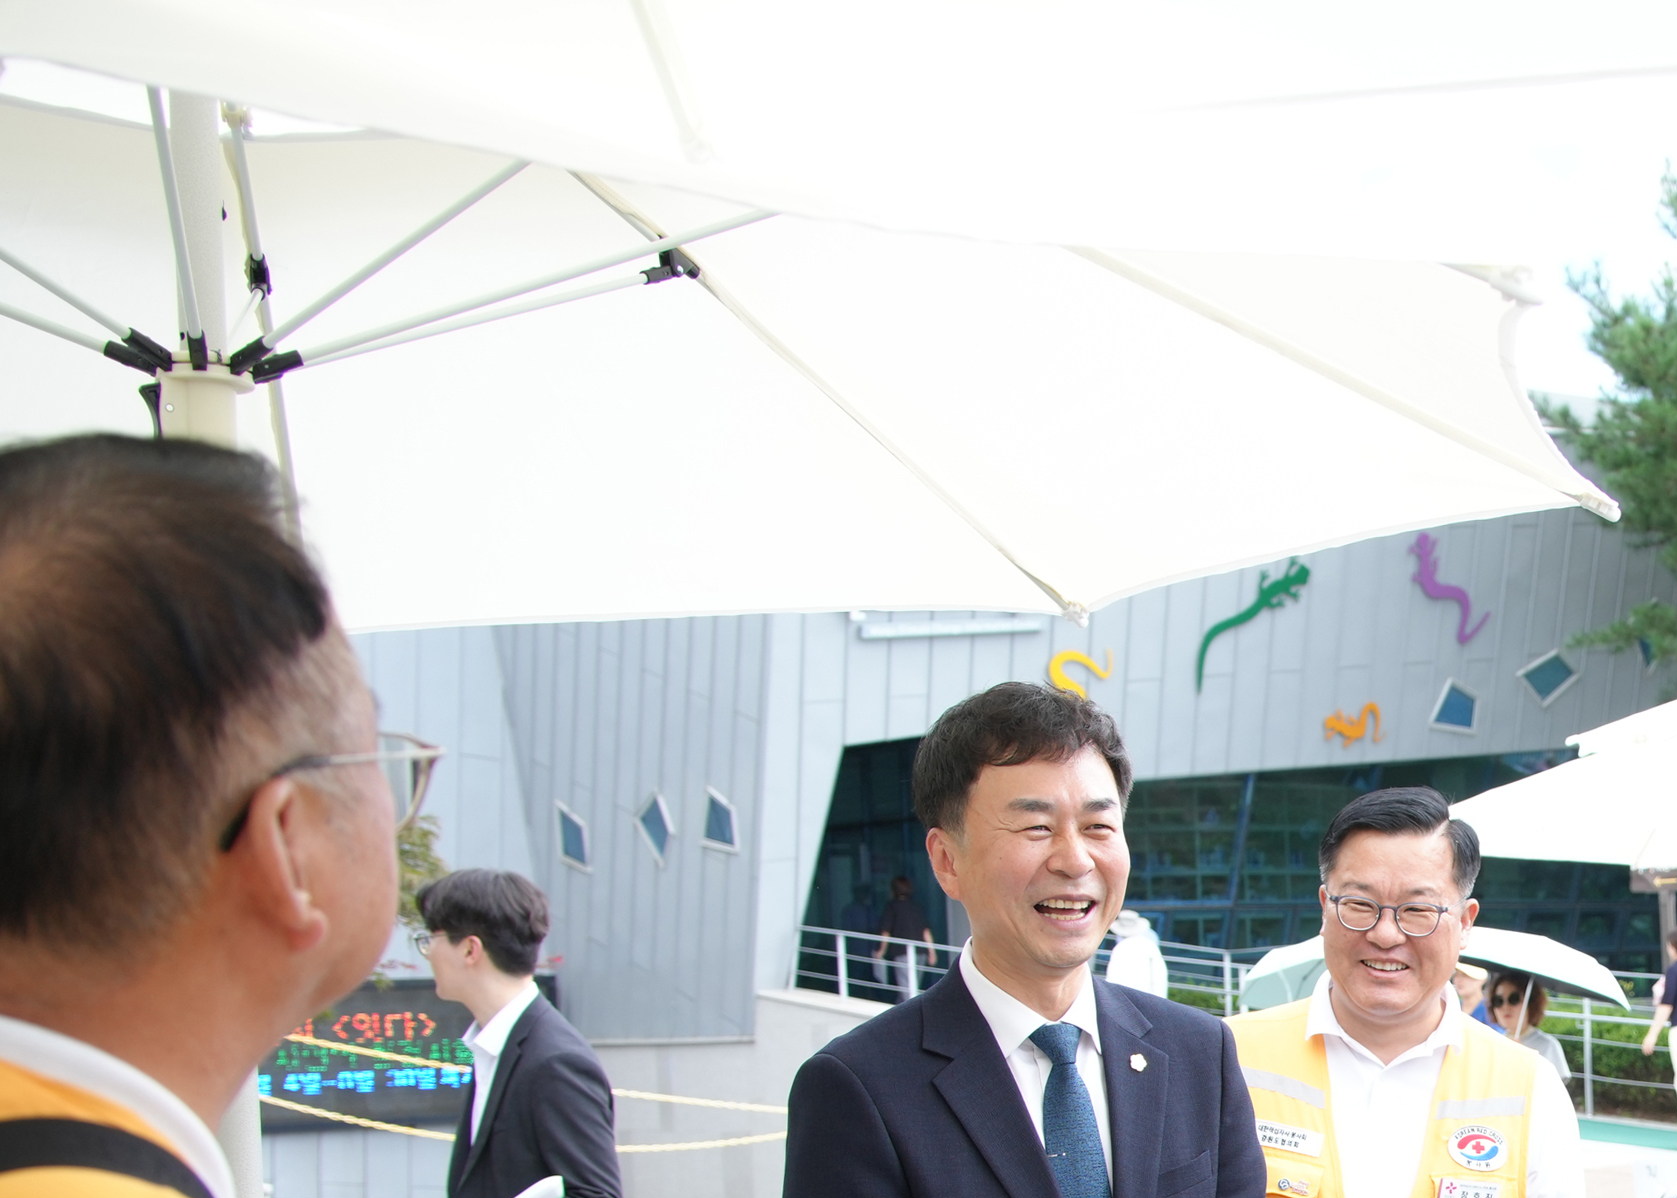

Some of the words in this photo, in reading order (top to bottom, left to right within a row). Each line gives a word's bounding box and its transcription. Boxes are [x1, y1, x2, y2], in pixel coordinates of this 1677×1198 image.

[1257, 1124, 1291, 1138] 대한적십자사
[1454, 1127, 1476, 1140] KOREAN
[1476, 1127, 1488, 1135] RED
[1488, 1130, 1503, 1146] CROSS
